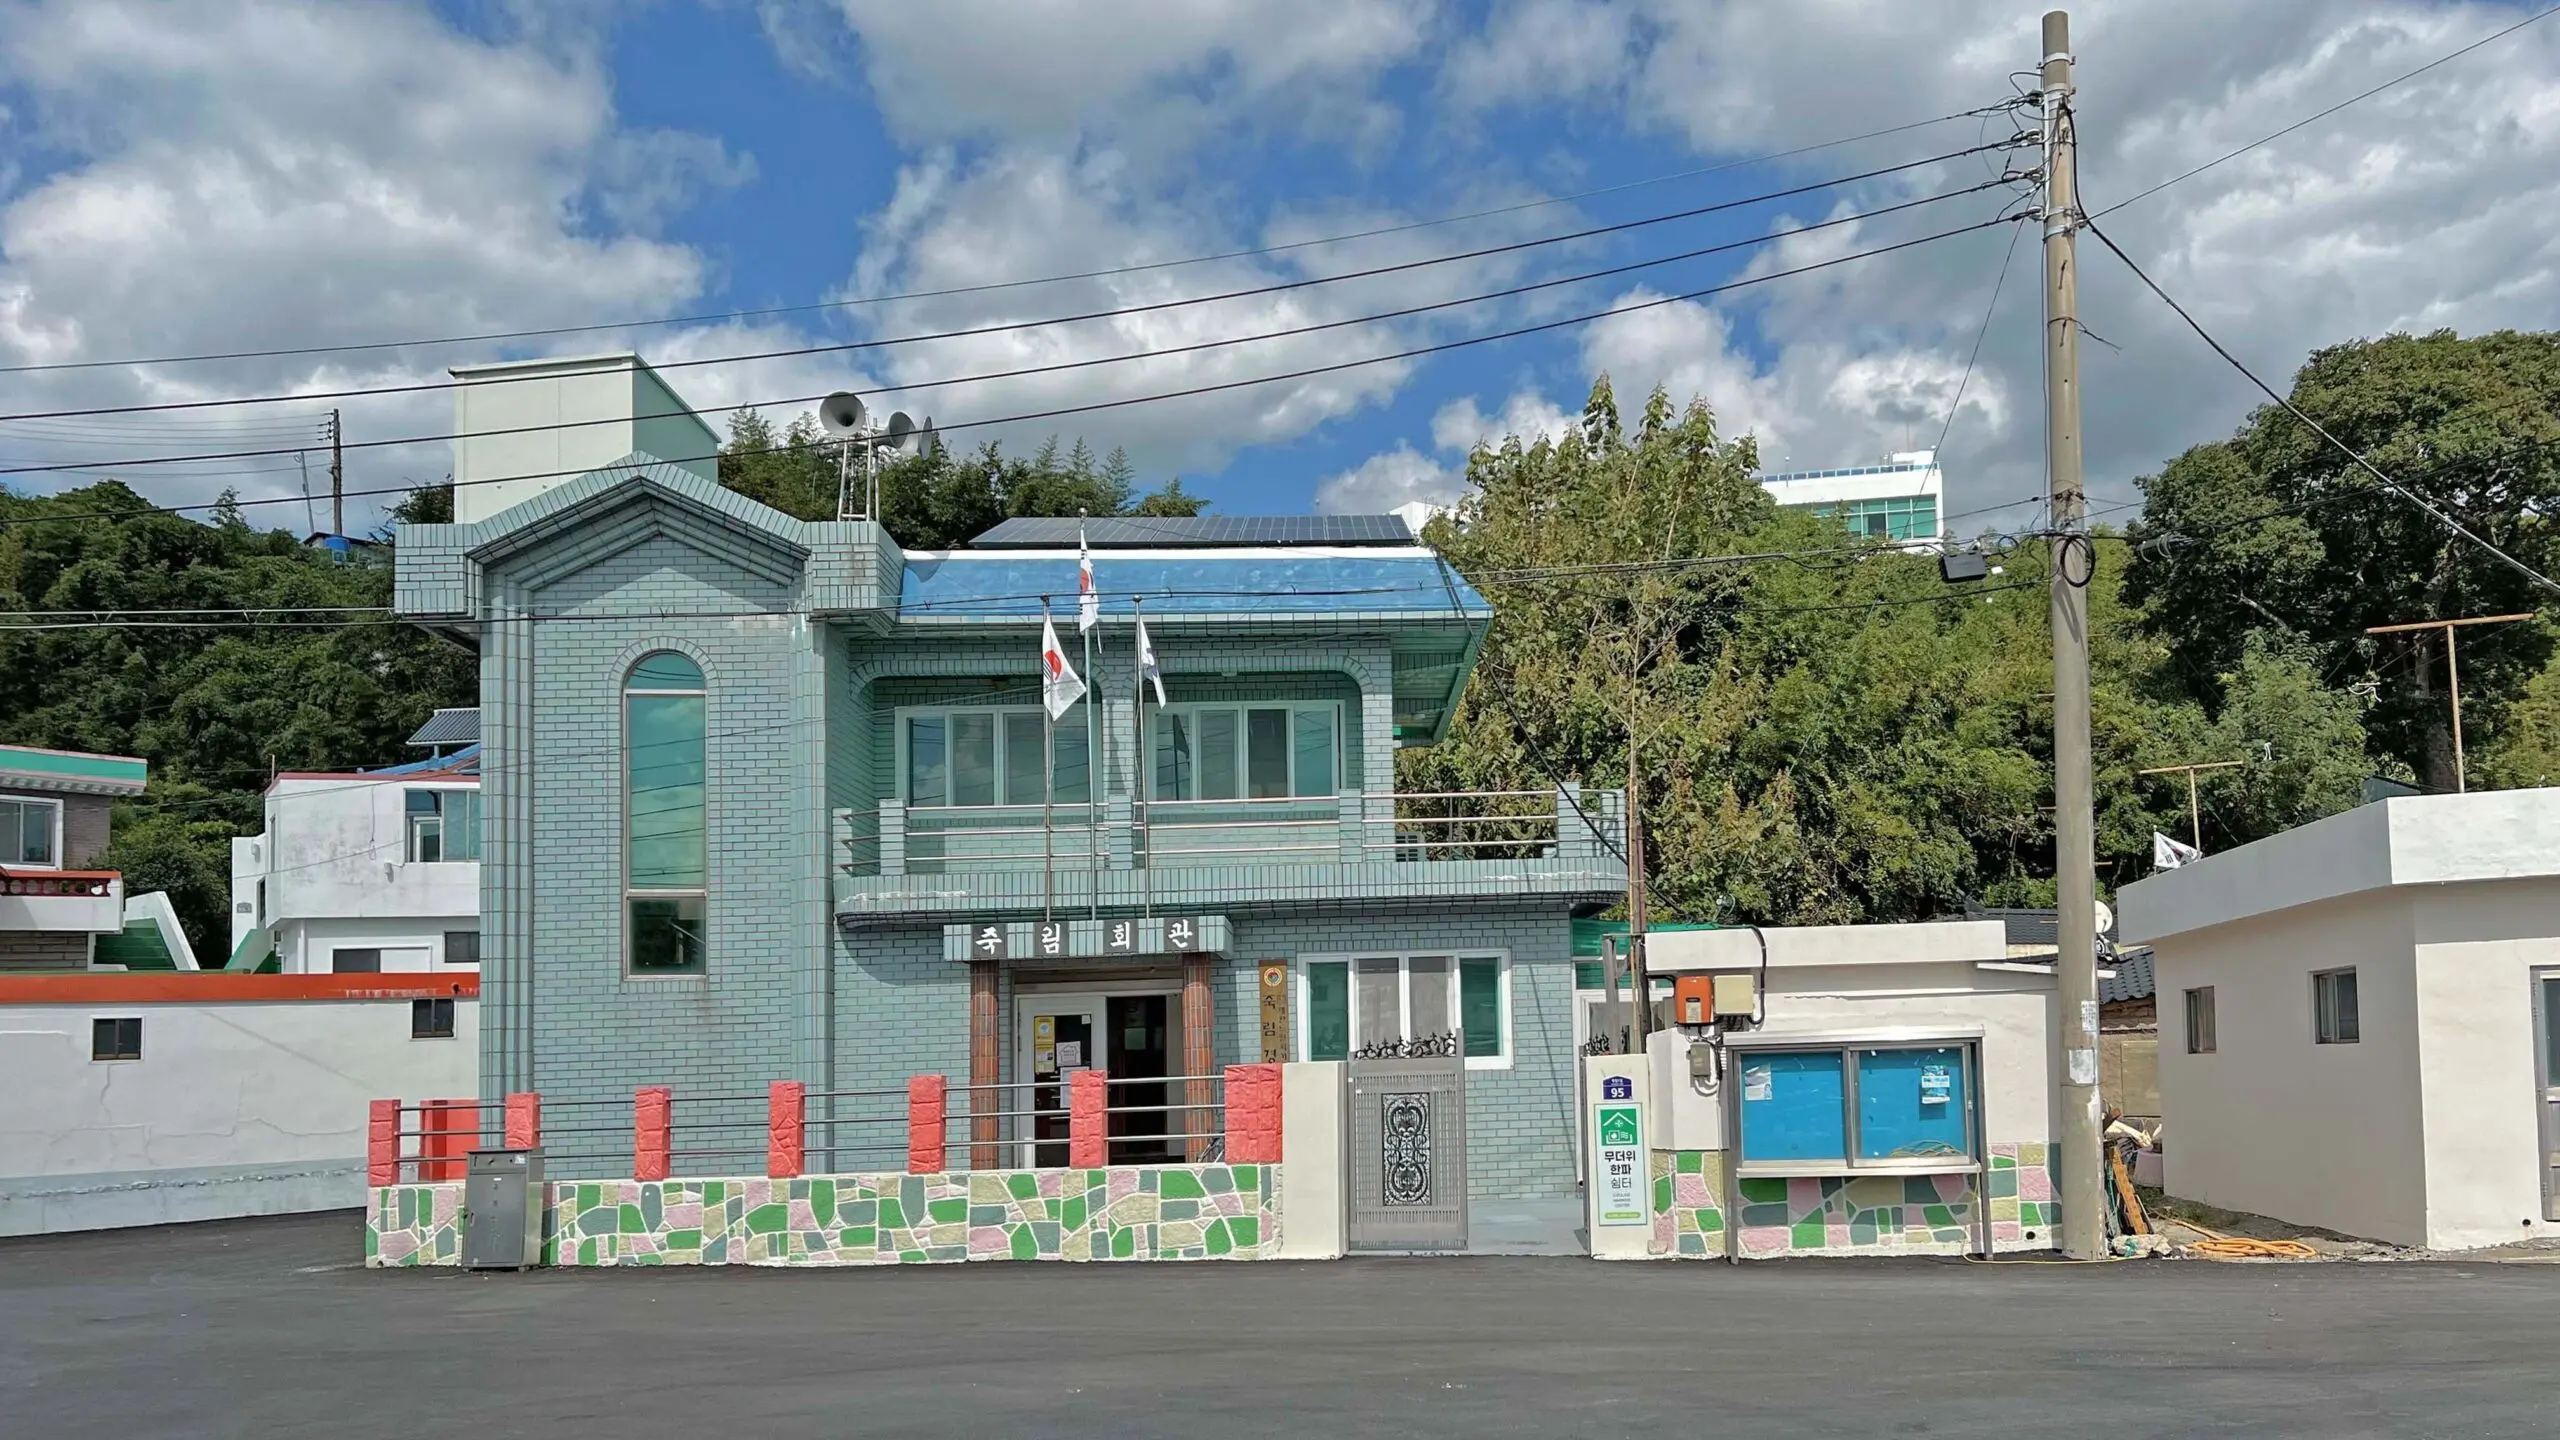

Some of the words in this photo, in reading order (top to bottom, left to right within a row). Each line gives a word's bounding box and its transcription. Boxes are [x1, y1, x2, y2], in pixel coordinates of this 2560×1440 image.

[1610, 1087, 1625, 1098] 95
[1604, 1150, 1636, 1162] 무더위
[1610, 1163, 1632, 1175] 한파
[1611, 1177, 1632, 1189] 쉼터
